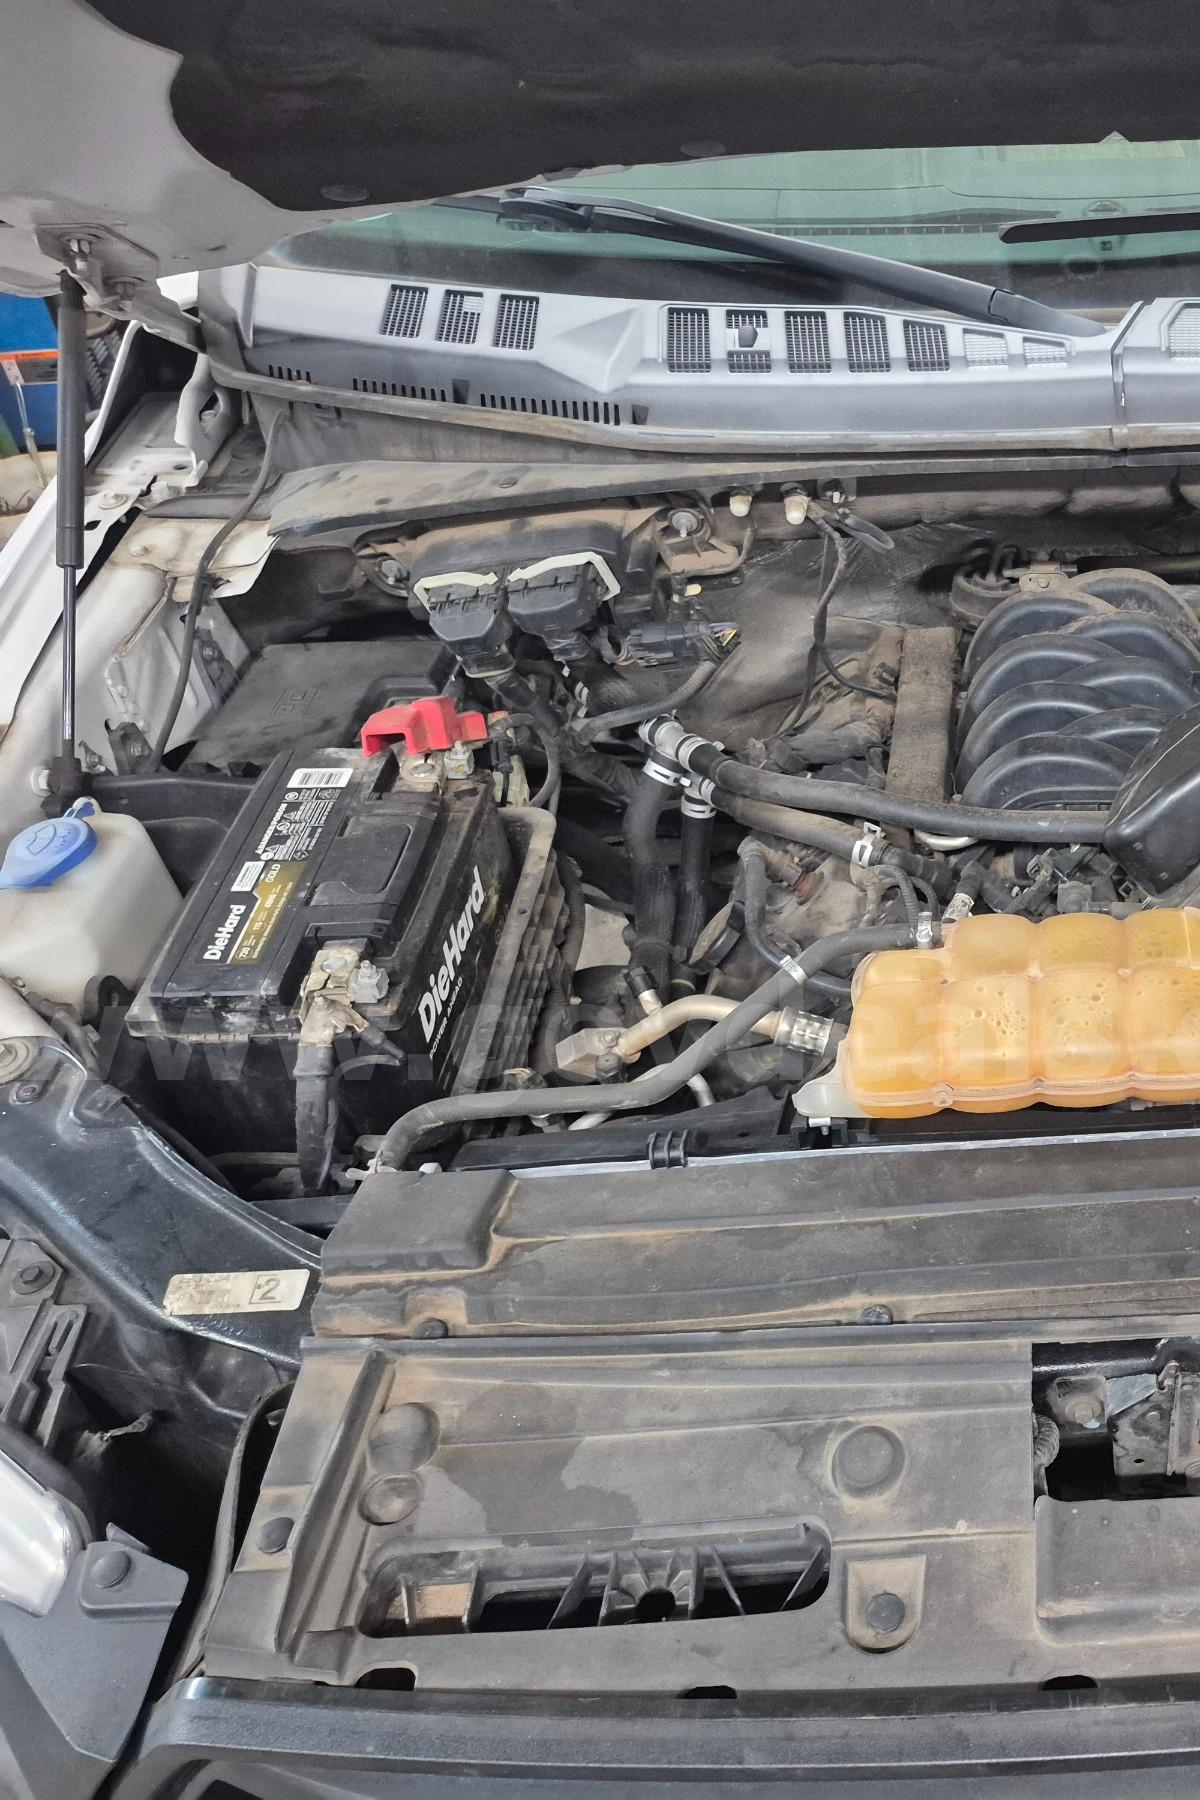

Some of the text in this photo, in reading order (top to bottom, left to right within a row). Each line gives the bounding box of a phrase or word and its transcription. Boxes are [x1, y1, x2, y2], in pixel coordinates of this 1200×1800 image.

[265, 863, 281, 883] GOLD
[203, 904, 247, 960] DieHard
[418, 864, 485, 1044] DieHard
[430, 976, 464, 1061] POWER AHEAD
[259, 1277, 281, 1301] 2
